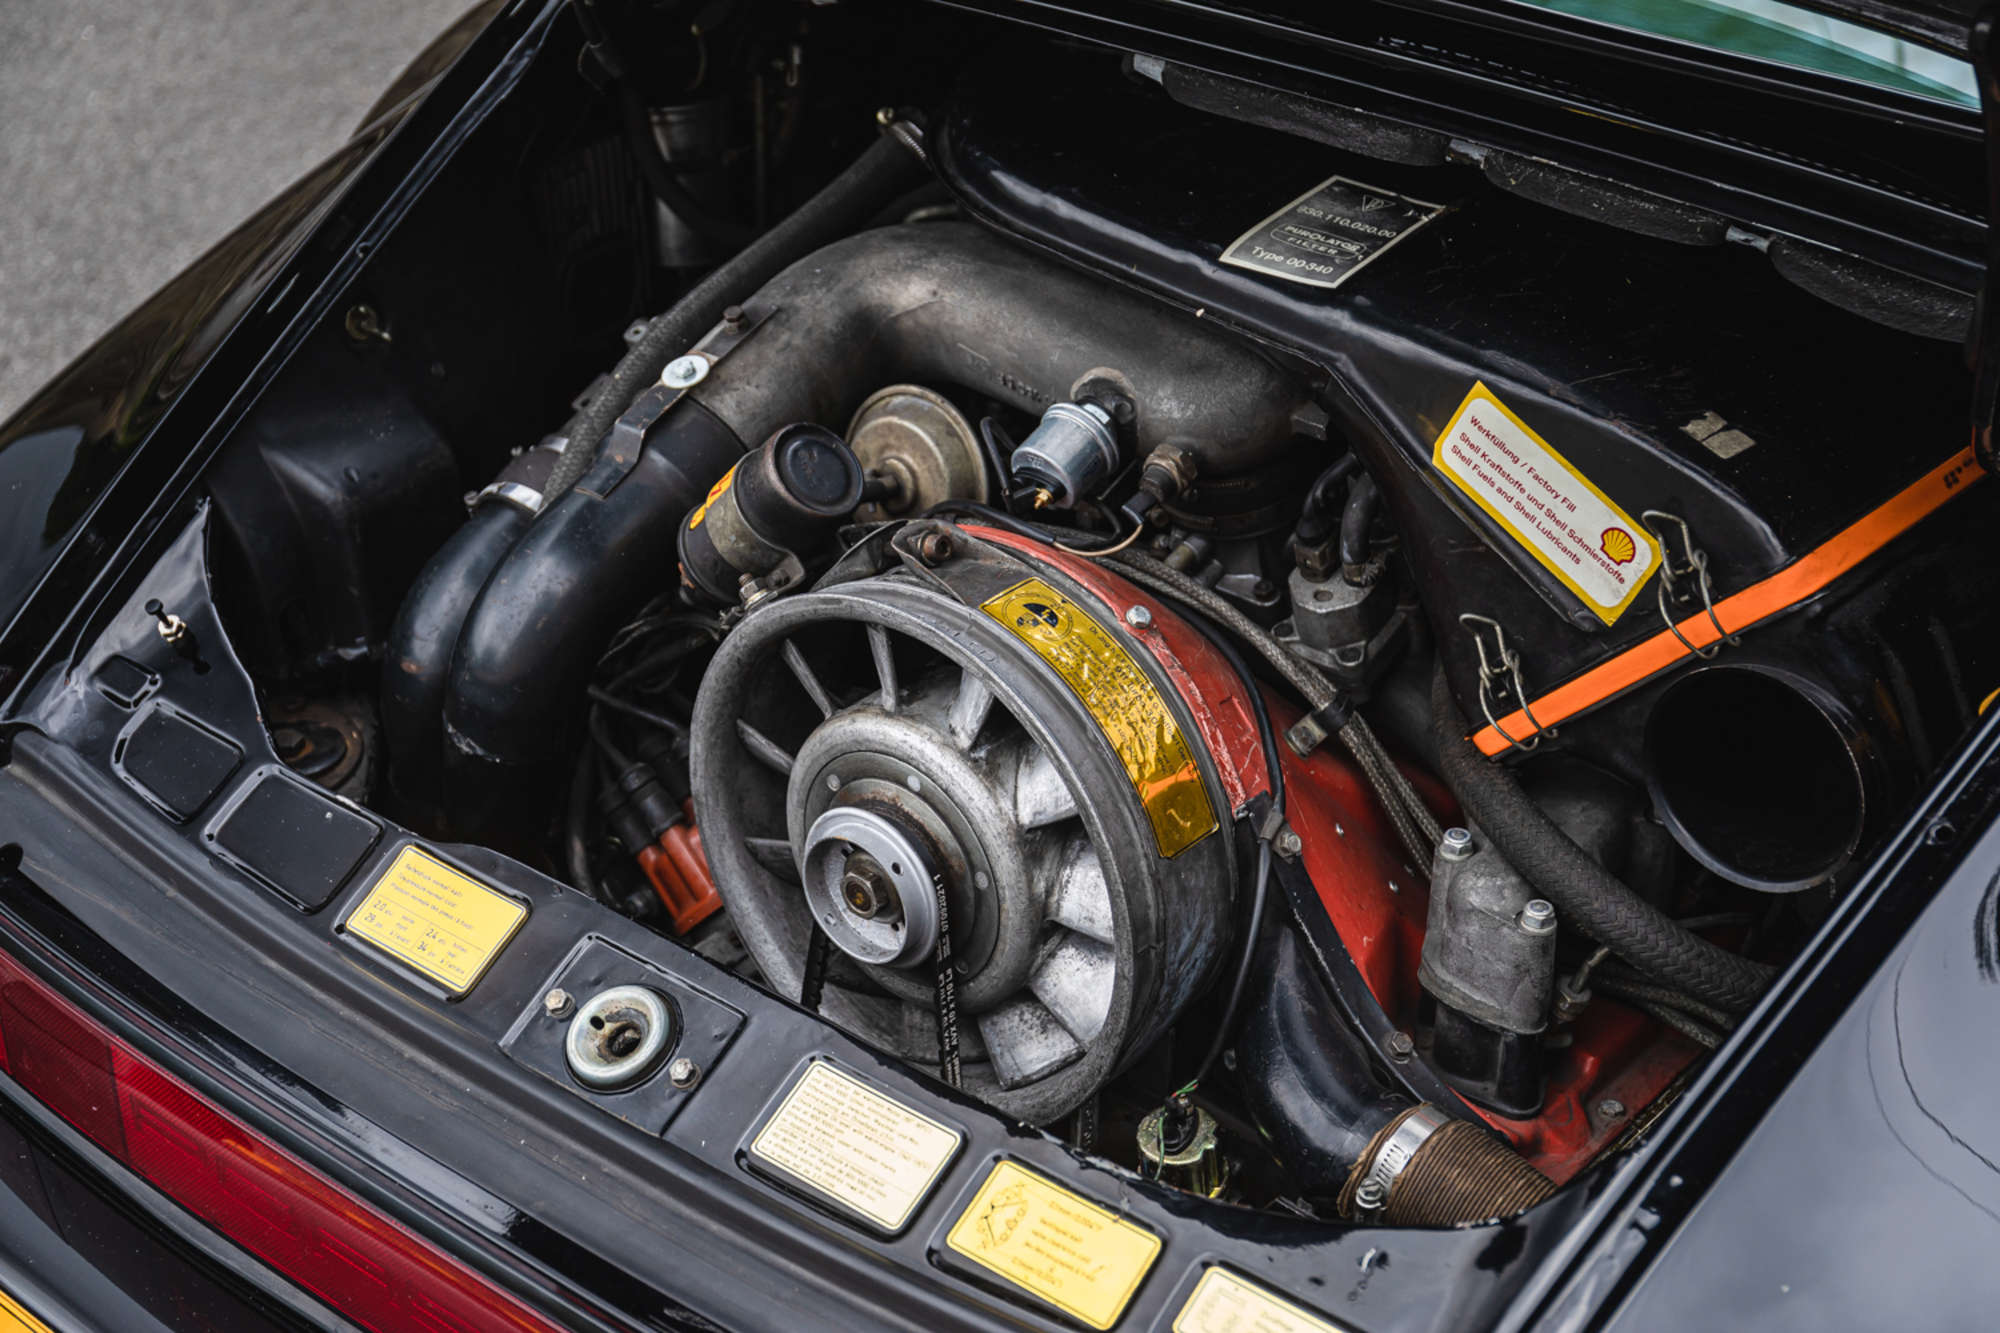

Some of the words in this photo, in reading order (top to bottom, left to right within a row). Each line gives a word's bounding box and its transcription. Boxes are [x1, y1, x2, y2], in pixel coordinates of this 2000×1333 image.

[1251, 246, 1284, 263] Type
[1284, 225, 1361, 252] PUROLATOR
[1287, 236, 1339, 255] FILTER
[1470, 415, 1520, 464] Werkfüllung
[1520, 461, 1528, 469] /
[1527, 465, 1561, 500] Factory
[1560, 497, 1577, 513] Fill
[1450, 444, 1472, 468] Shell
[1472, 464, 1496, 488] Fuels
[1496, 485, 1514, 503] and
[1513, 501, 1536, 524] Shell
[1536, 521, 1582, 565] Lubricants
[1459, 432, 1481, 455] Shell
[1480, 451, 1526, 495] Kraftstoffe
[1527, 492, 1544, 511] und
[1544, 505, 1567, 532] Shell
[1567, 528, 1625, 585] Schmierstoffe
